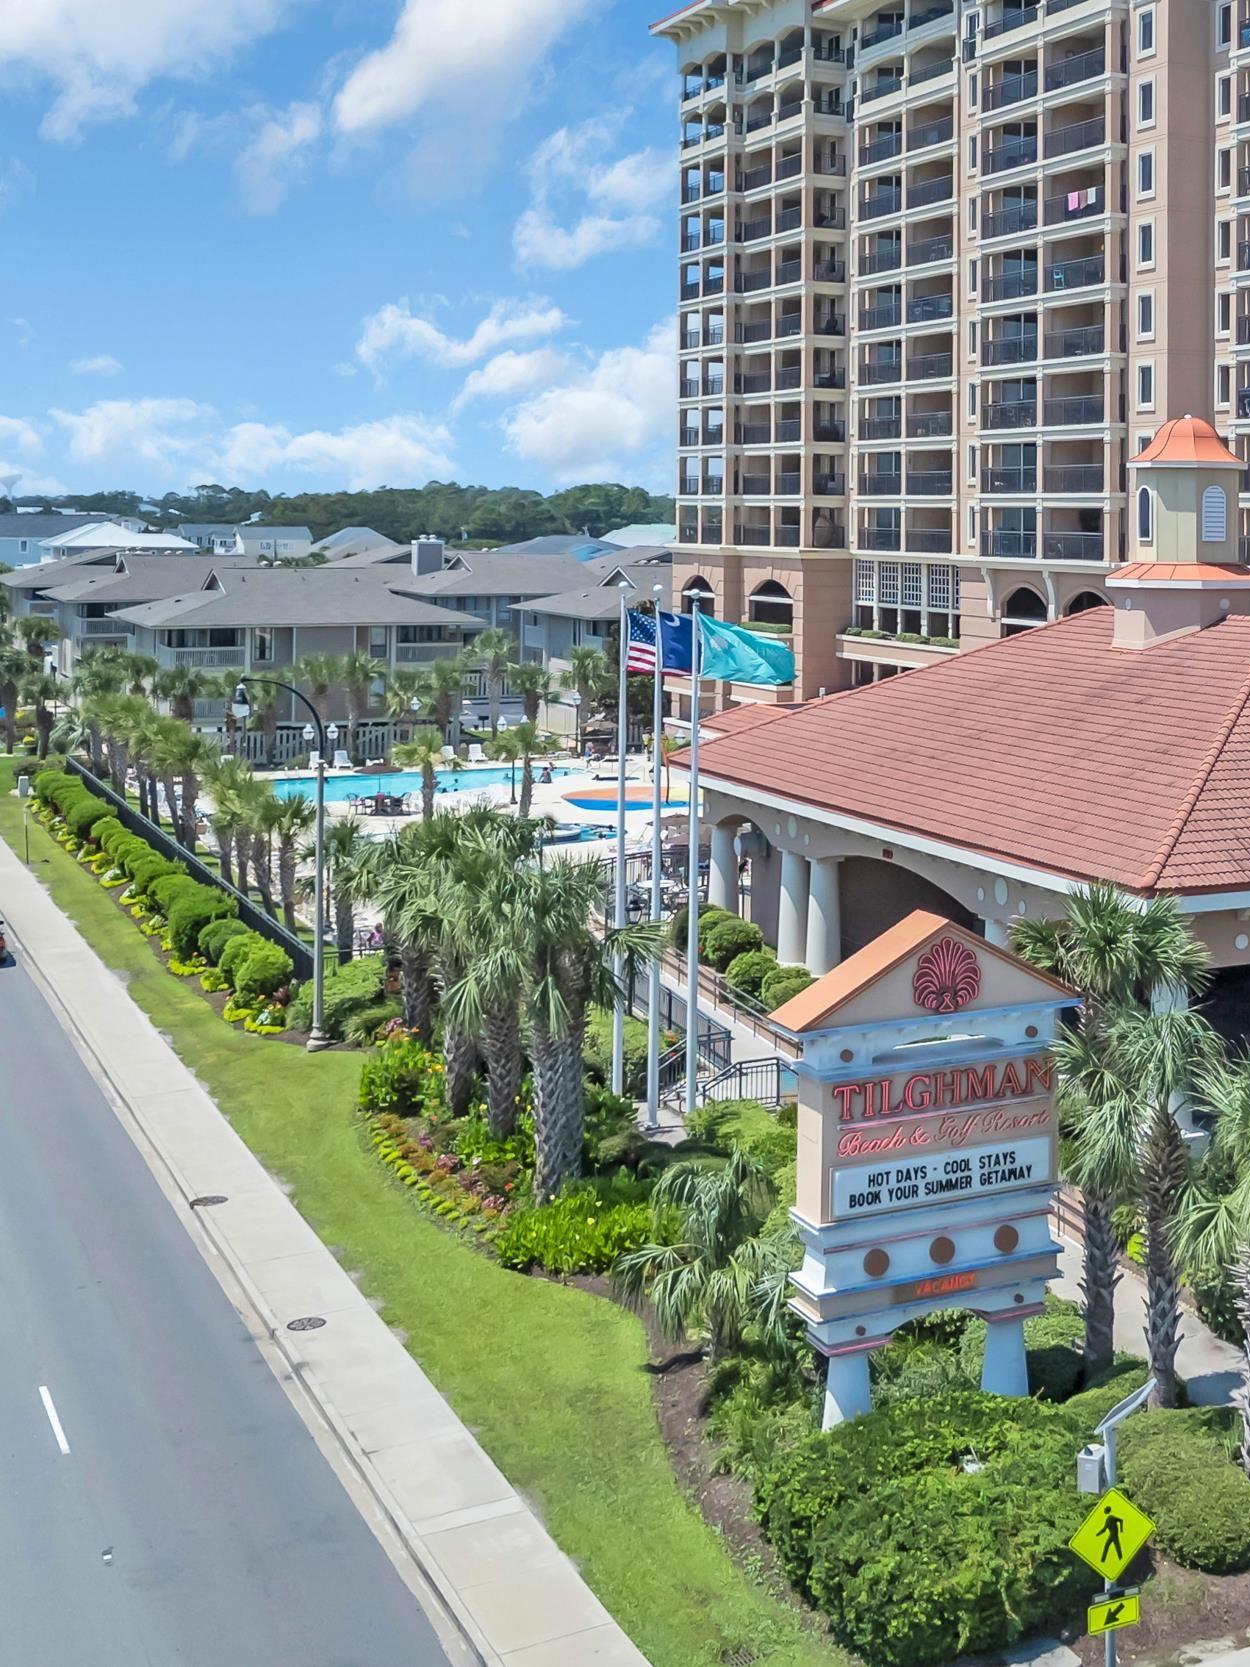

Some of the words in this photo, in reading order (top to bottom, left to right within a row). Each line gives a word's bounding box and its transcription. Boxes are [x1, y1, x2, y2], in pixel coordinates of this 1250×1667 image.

[834, 1057, 1053, 1120] TILGHMAN
[838, 1128, 906, 1157] Beach
[909, 1126, 931, 1146] &
[934, 1114, 982, 1145] Golf
[980, 1107, 1050, 1135] Resort
[849, 1189, 882, 1209] BOOK
[888, 1183, 919, 1203] YOUR
[924, 1175, 973, 1196] SUMMER
[979, 1165, 1033, 1186] GETAWAY
[867, 1170, 892, 1188] HOT
[895, 1165, 928, 1184] DAYS
[943, 1157, 972, 1175] COOL
[978, 1150, 1017, 1170] STAYS
